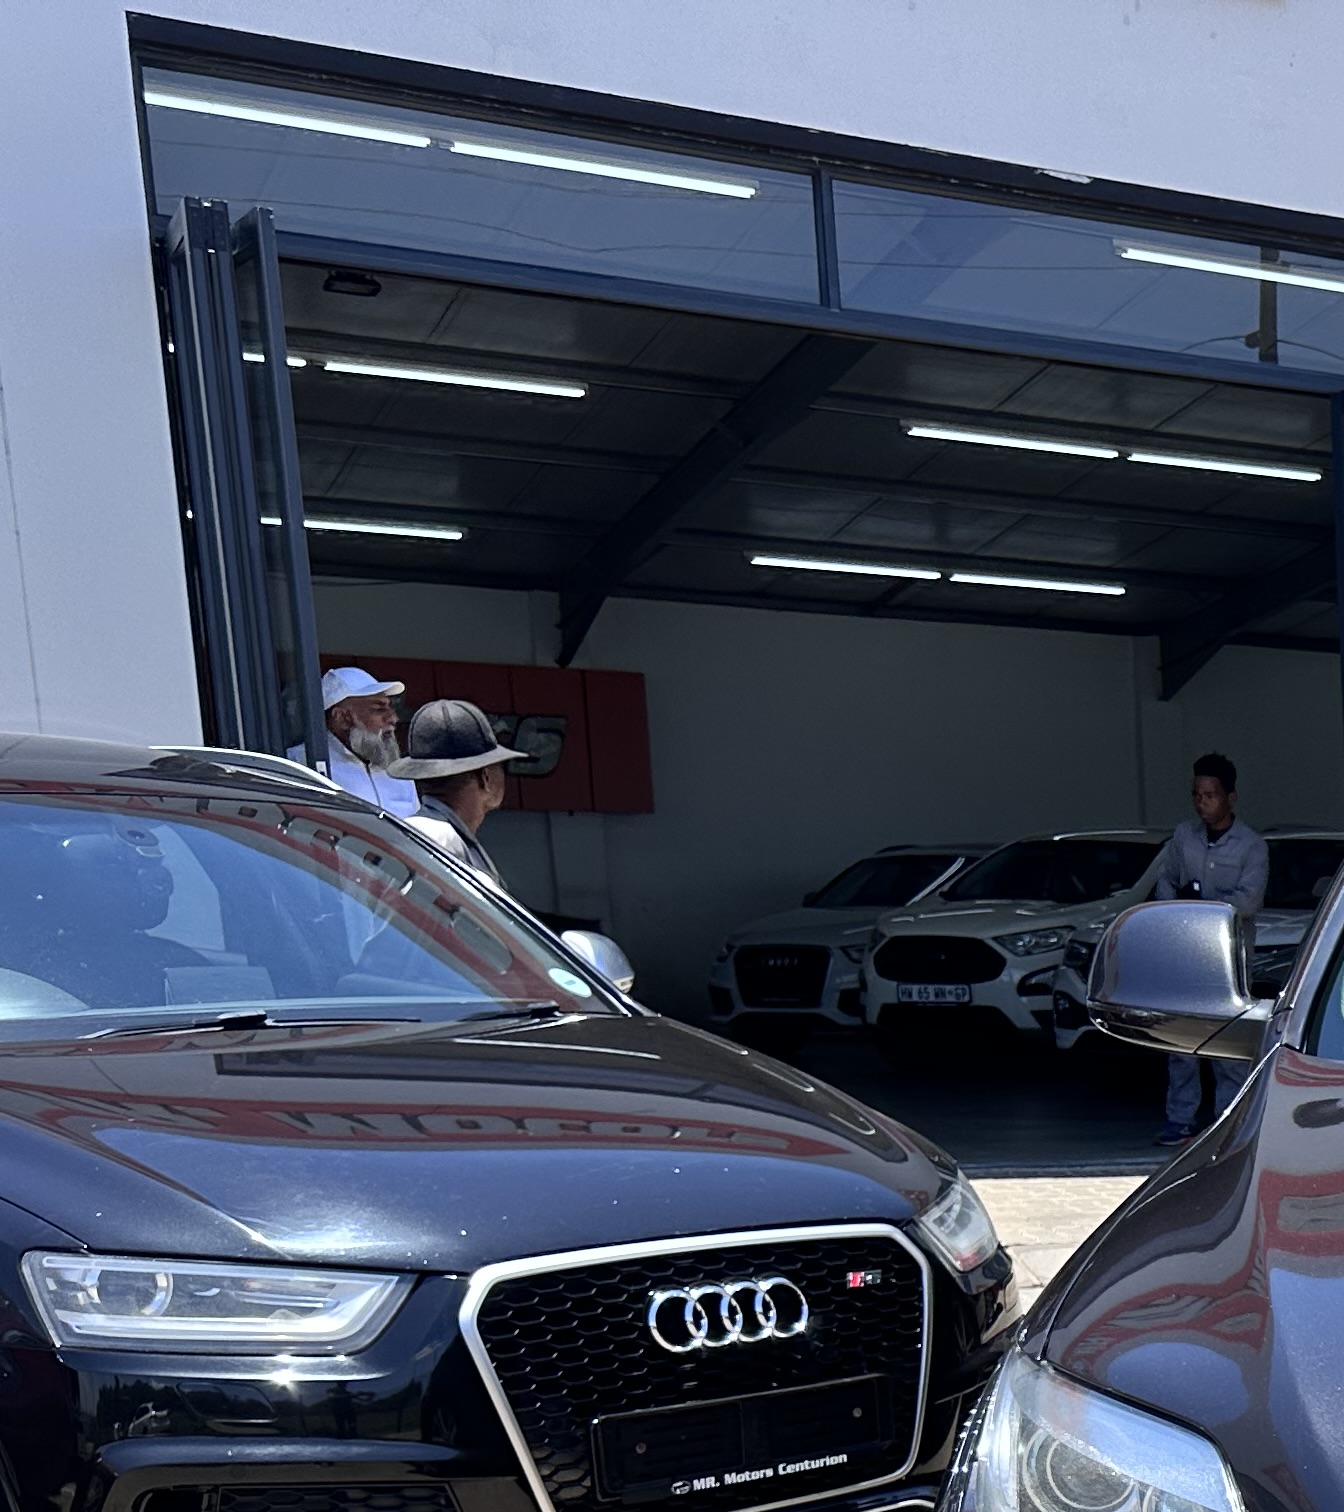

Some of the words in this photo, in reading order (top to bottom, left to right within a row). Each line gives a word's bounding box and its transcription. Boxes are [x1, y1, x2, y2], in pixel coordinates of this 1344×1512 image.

[692, 1476, 721, 1491] MR.
[724, 1468, 774, 1485] Motors
[778, 1453, 848, 1475] Centurion
